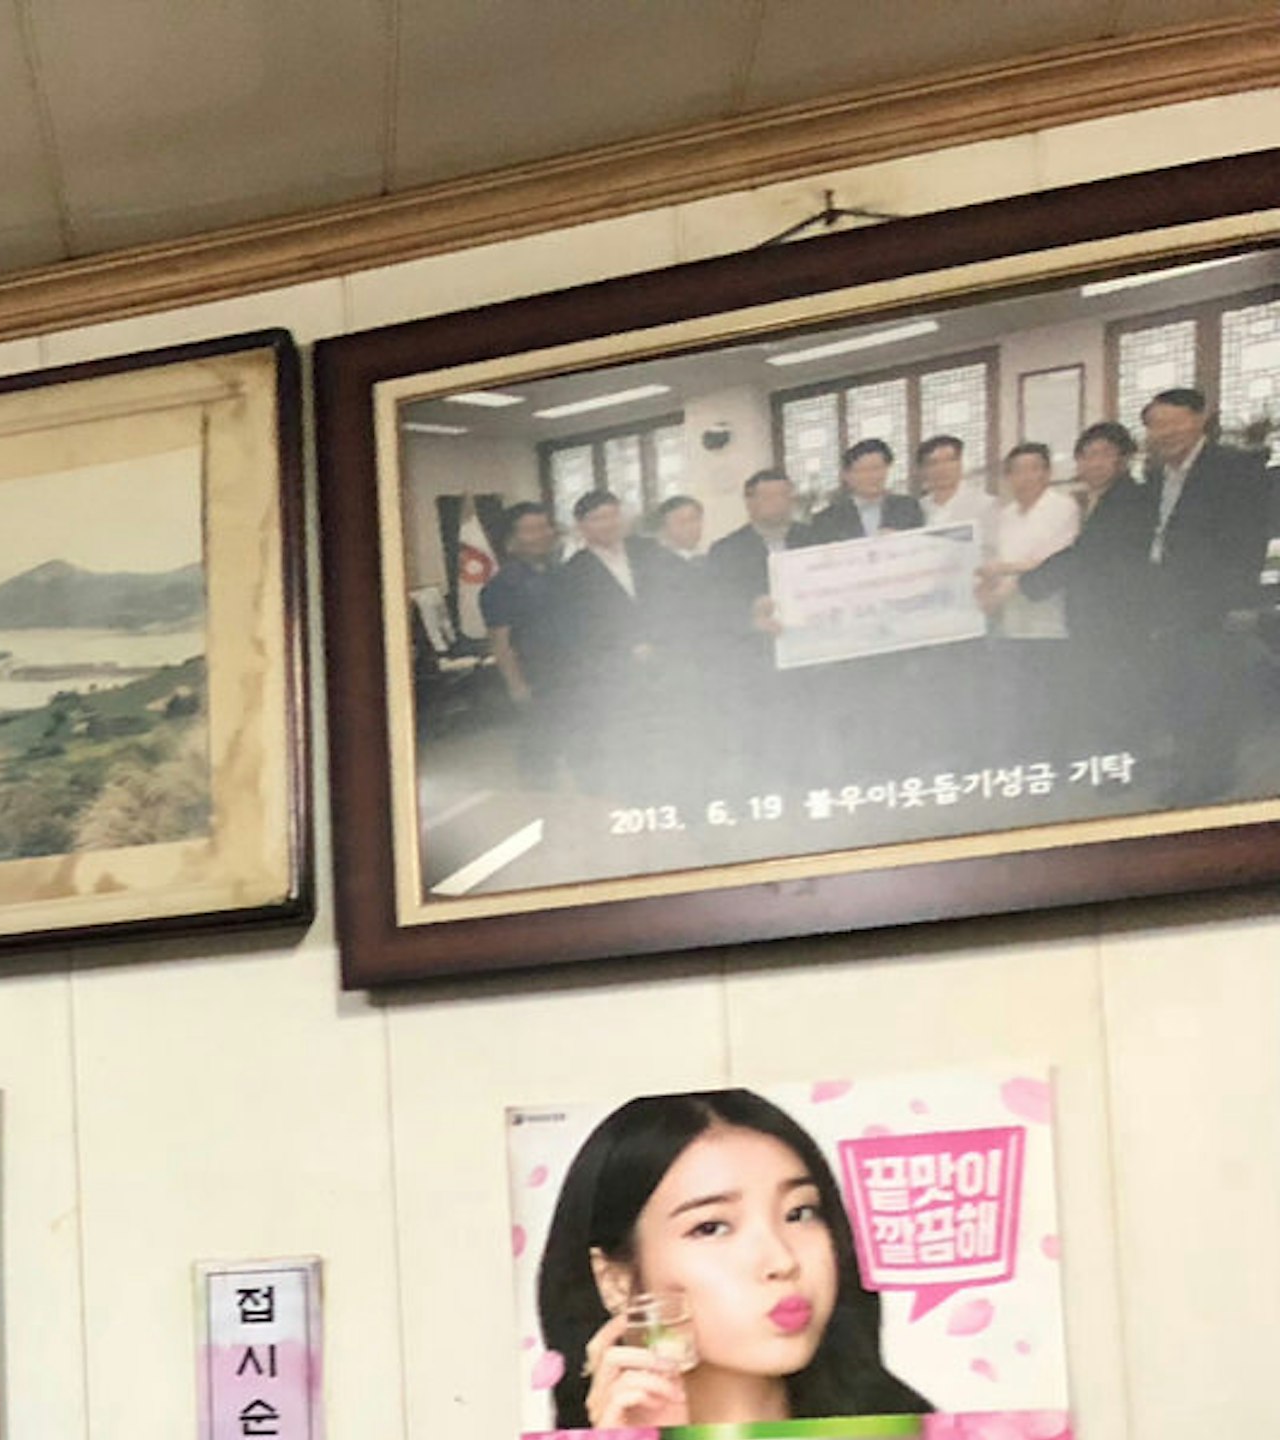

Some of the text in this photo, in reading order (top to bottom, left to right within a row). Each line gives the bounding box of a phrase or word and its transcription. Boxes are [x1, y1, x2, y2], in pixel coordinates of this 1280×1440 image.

[609, 752, 1136, 836] 2013. 6. 19 불우이웃돕기성금 기탁
[863, 1148, 1000, 1216] 끝맛이
[871, 1200, 996, 1266] 깔끔해
